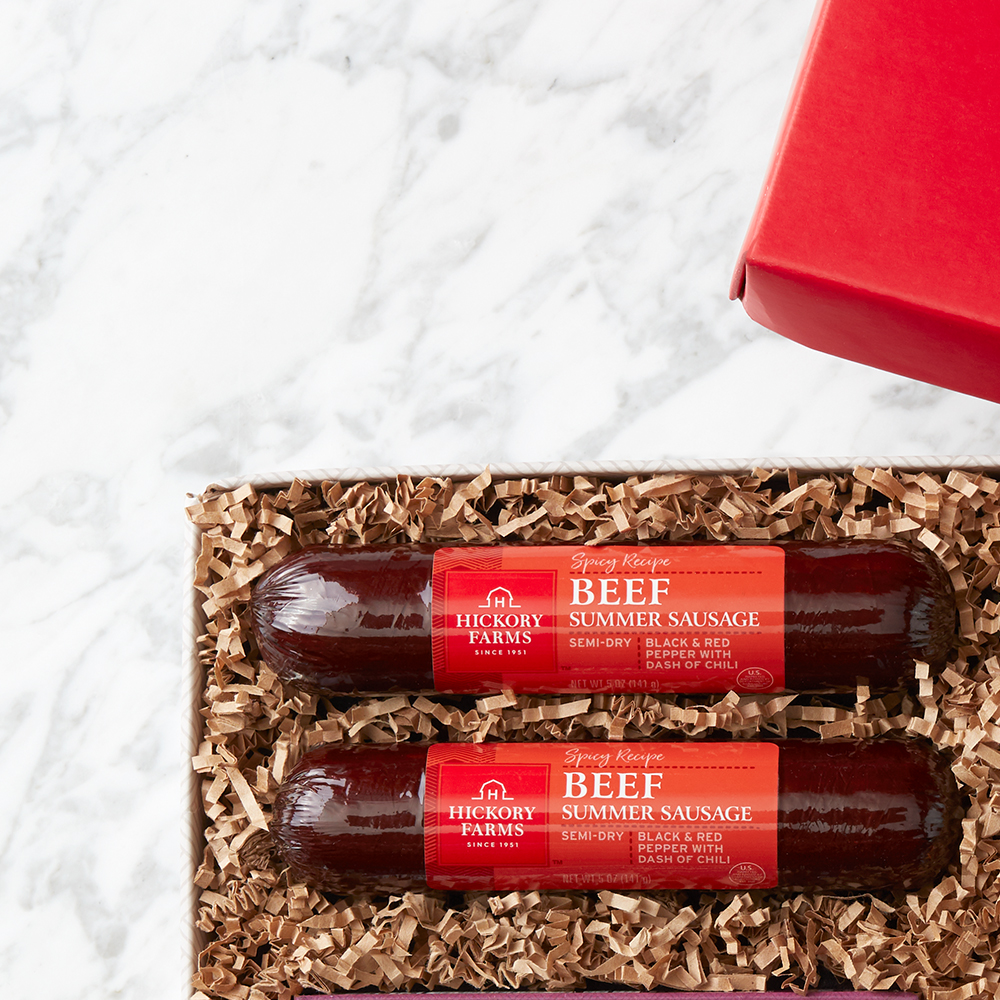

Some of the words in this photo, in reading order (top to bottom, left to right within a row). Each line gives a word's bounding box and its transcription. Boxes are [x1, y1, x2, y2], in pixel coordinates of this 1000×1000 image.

[571, 552, 617, 573] Spicy
[622, 553, 672, 572] Recipe
[570, 578, 670, 606] BEEF
[456, 615, 543, 627] HICKORY
[570, 612, 661, 627] SUMMER
[668, 612, 760, 627] SAUSAGE
[469, 631, 532, 644] FARMS
[569, 639, 632, 647] SEMI-DRY
[646, 639, 688, 647] BLACK
[693, 639, 701, 647] &
[705, 639, 730, 647] RED
[646, 651, 697, 659] PEPPER
[701, 651, 731, 659] WITH
[647, 661, 681, 669] DASH
[685, 661, 701, 669] OF
[705, 661, 738, 669] CHILI
[563, 748, 612, 768] Spicy
[616, 748, 665, 767] Recipe
[563, 772, 663, 799] BEEF
[449, 806, 536, 819] HICKORY
[562, 805, 654, 821] SUMMER
[661, 806, 753, 821] SAUSAGE
[461, 823, 524, 836] FARMS
[562, 831, 624, 841] SEMI-DRY
[638, 832, 680, 841] BLACK
[684, 832, 693, 841] &
[697, 832, 722, 841] RED
[638, 844, 688, 853] PEPPER
[692, 845, 723, 853] WITH
[638, 855, 673, 864] DASH
[676, 856, 693, 864] OF
[697, 856, 730, 864] CHILI
